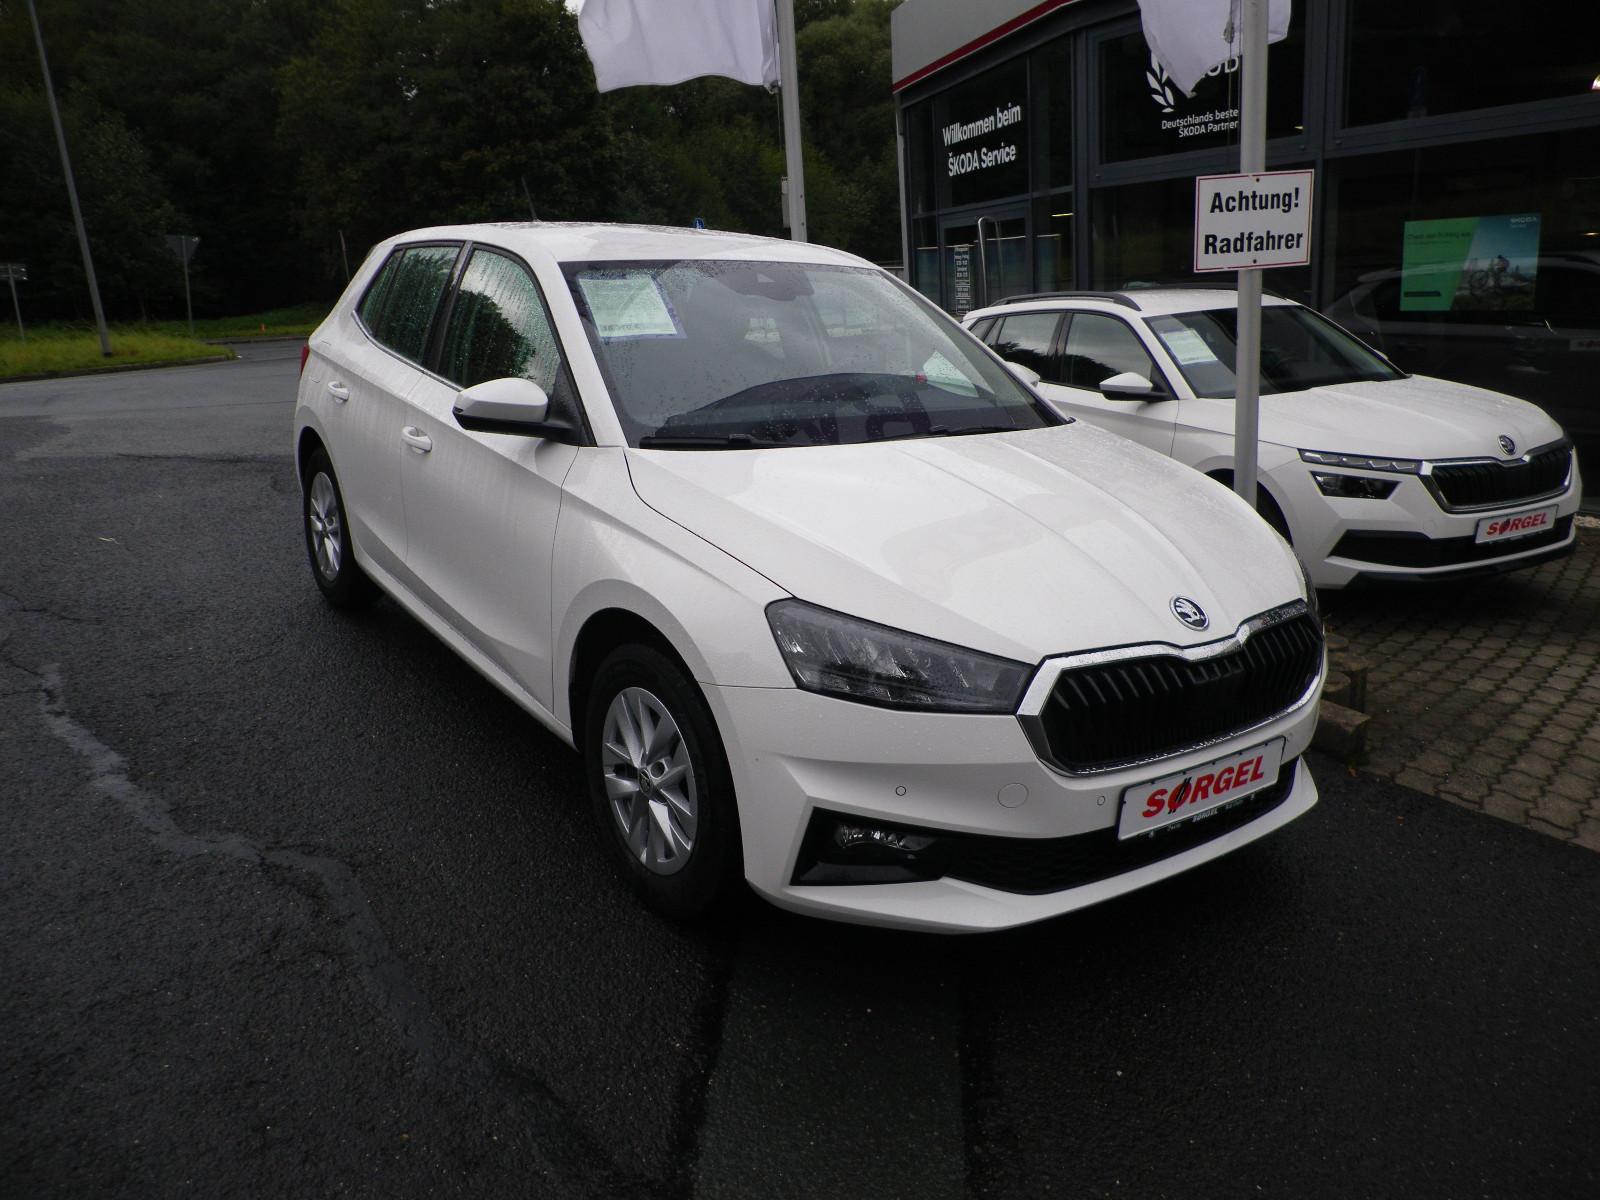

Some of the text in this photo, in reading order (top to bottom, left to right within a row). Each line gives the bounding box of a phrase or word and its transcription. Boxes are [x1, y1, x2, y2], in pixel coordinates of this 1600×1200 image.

[942, 102, 1021, 147] Willkommen beim
[1161, 109, 1239, 129] Deutschlands beste
[1178, 120, 1239, 138] ŠKODA Partner
[948, 141, 1016, 177] ŠKODA Service
[1210, 187, 1300, 213] Achtung!
[1204, 230, 1303, 255] Radfahrer
